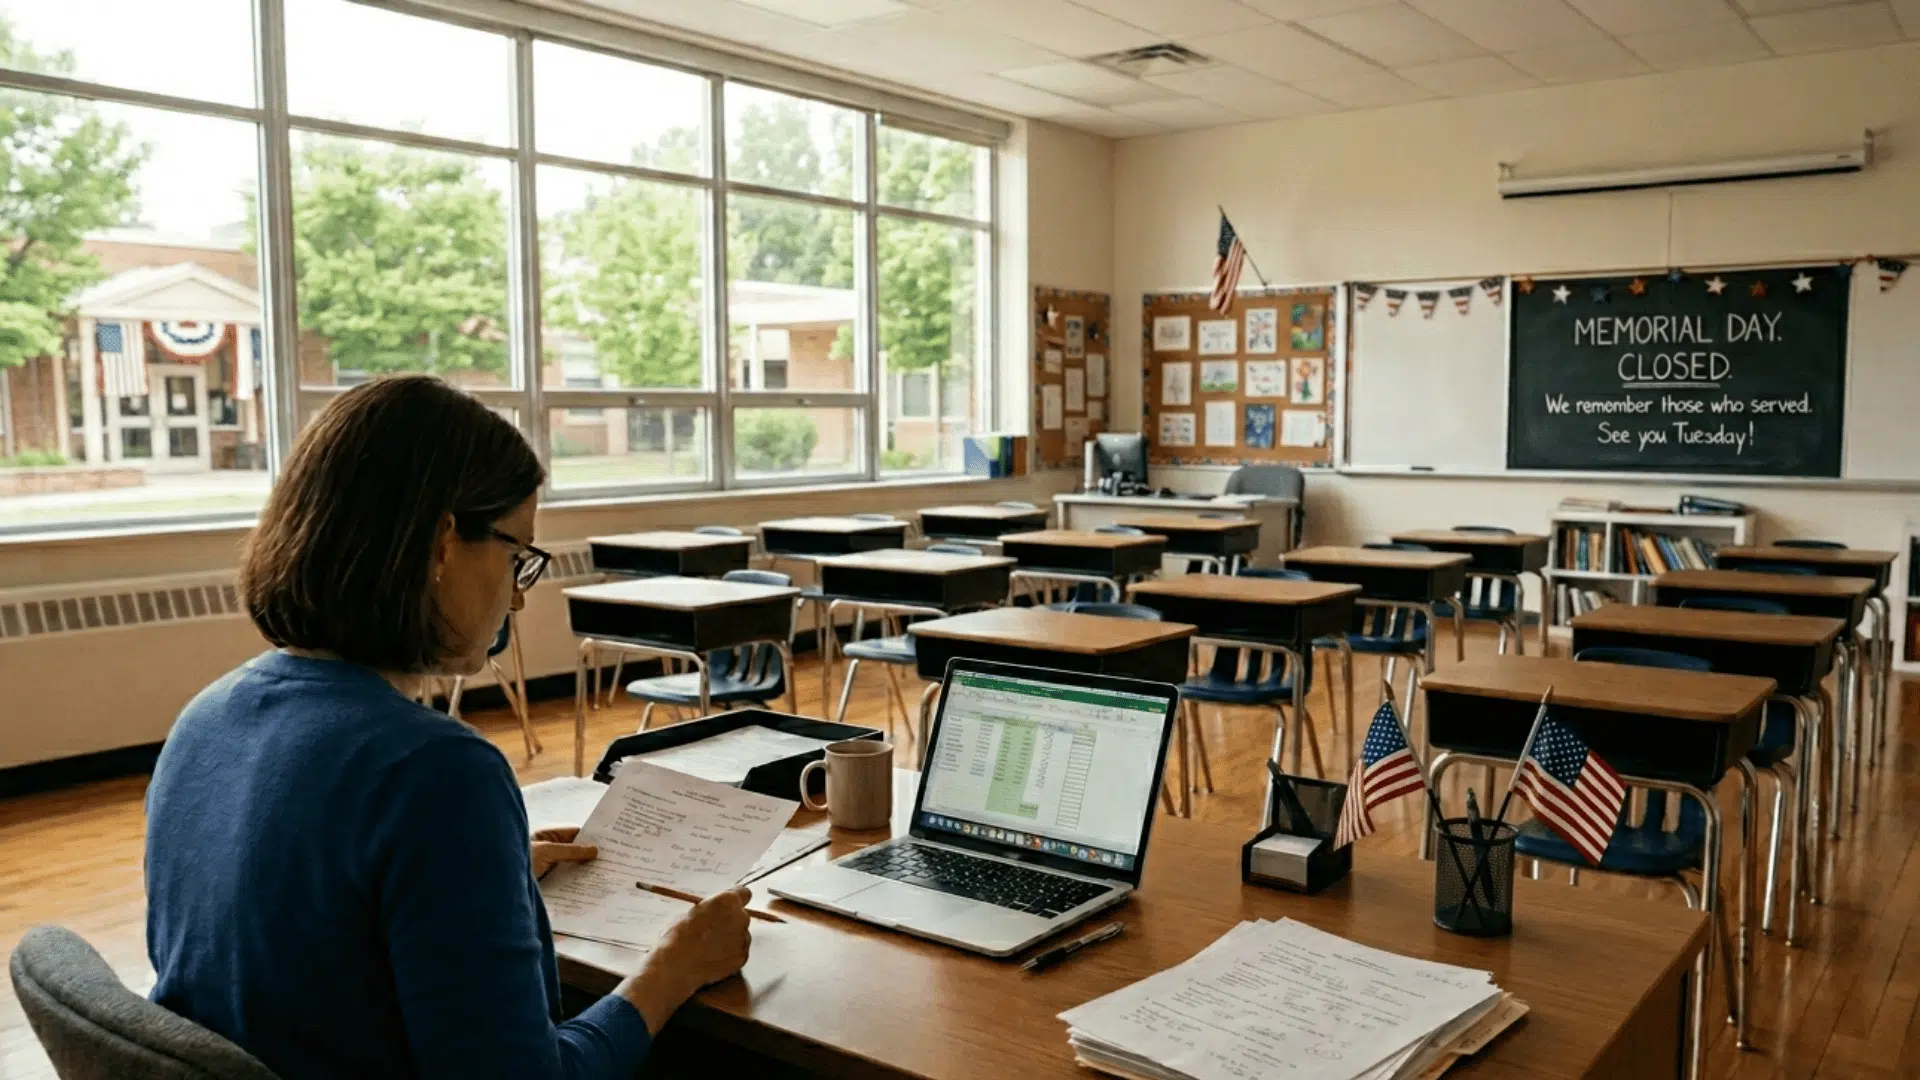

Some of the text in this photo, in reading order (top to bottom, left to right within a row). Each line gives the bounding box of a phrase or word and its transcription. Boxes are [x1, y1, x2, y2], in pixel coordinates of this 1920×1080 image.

[1575, 312, 1782, 346] MEMORIAL DAY.
[1618, 352, 1732, 381] CLOSED.
[1545, 393, 1812, 414] We remember those who served.
[1597, 421, 1754, 455] See you Tuesday!
